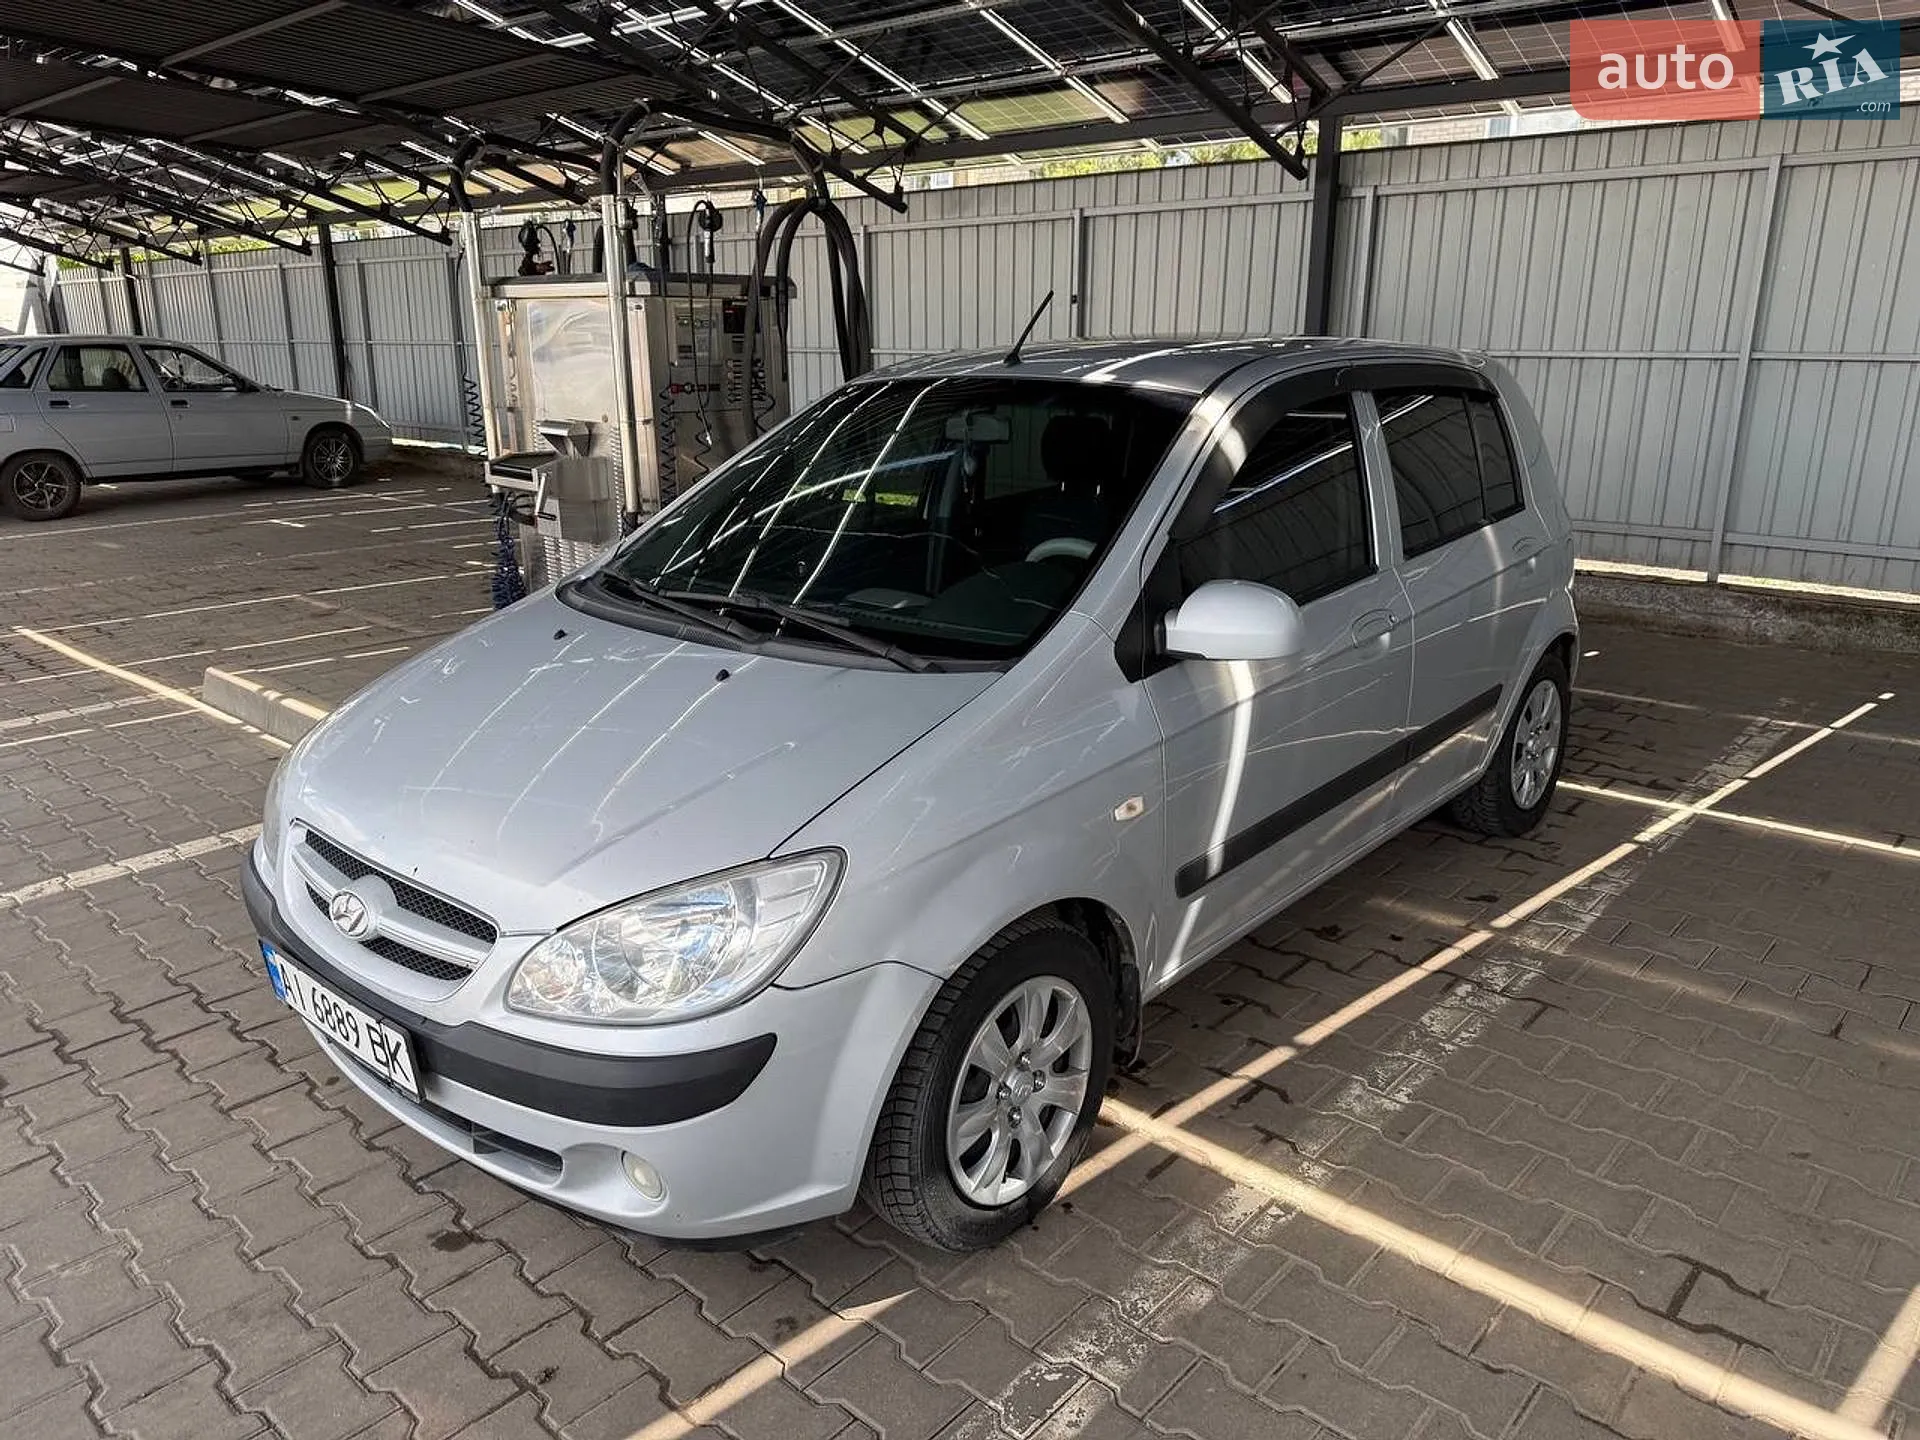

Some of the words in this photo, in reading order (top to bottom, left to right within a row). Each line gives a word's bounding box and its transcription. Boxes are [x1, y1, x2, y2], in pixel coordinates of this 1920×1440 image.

[280, 962, 306, 1011] AI
[312, 987, 360, 1048] 6889
[366, 1022, 410, 1082] BK
